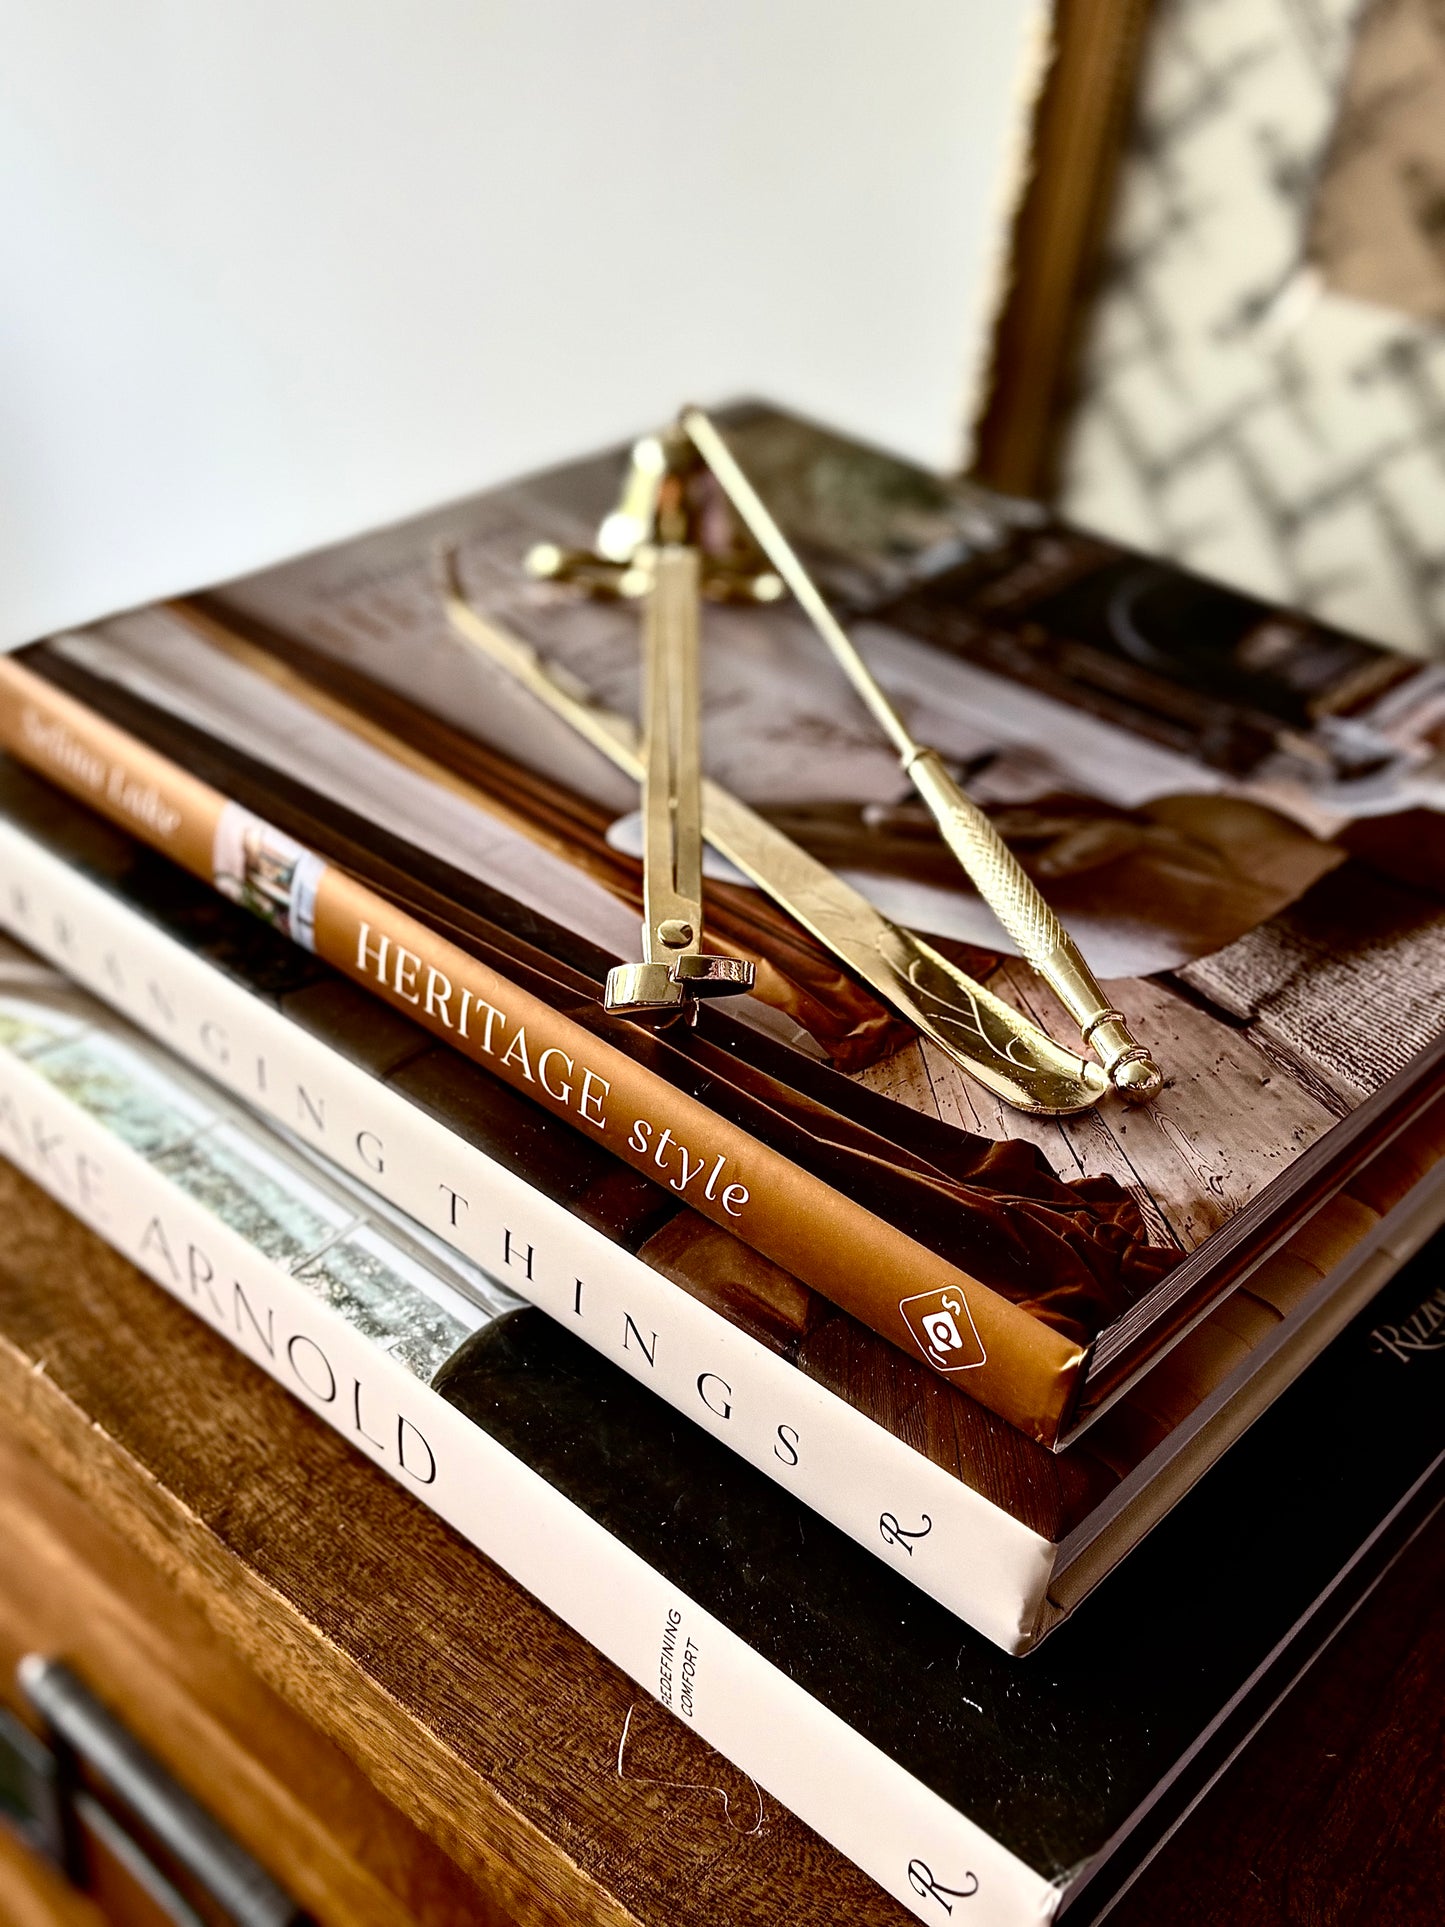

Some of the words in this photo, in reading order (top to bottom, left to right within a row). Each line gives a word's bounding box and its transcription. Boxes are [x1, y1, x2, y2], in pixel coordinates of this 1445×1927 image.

[355, 922, 611, 1130] HERITAGE
[627, 1118, 750, 1218] style
[137, 1215, 437, 1485] ARNOLD
[438, 1183, 801, 1467] THINGS
[879, 1511, 933, 1557] R
[659, 1608, 682, 1710] REDEFINING
[680, 1636, 700, 1718] COMFORT
[907, 1857, 980, 1917] R
